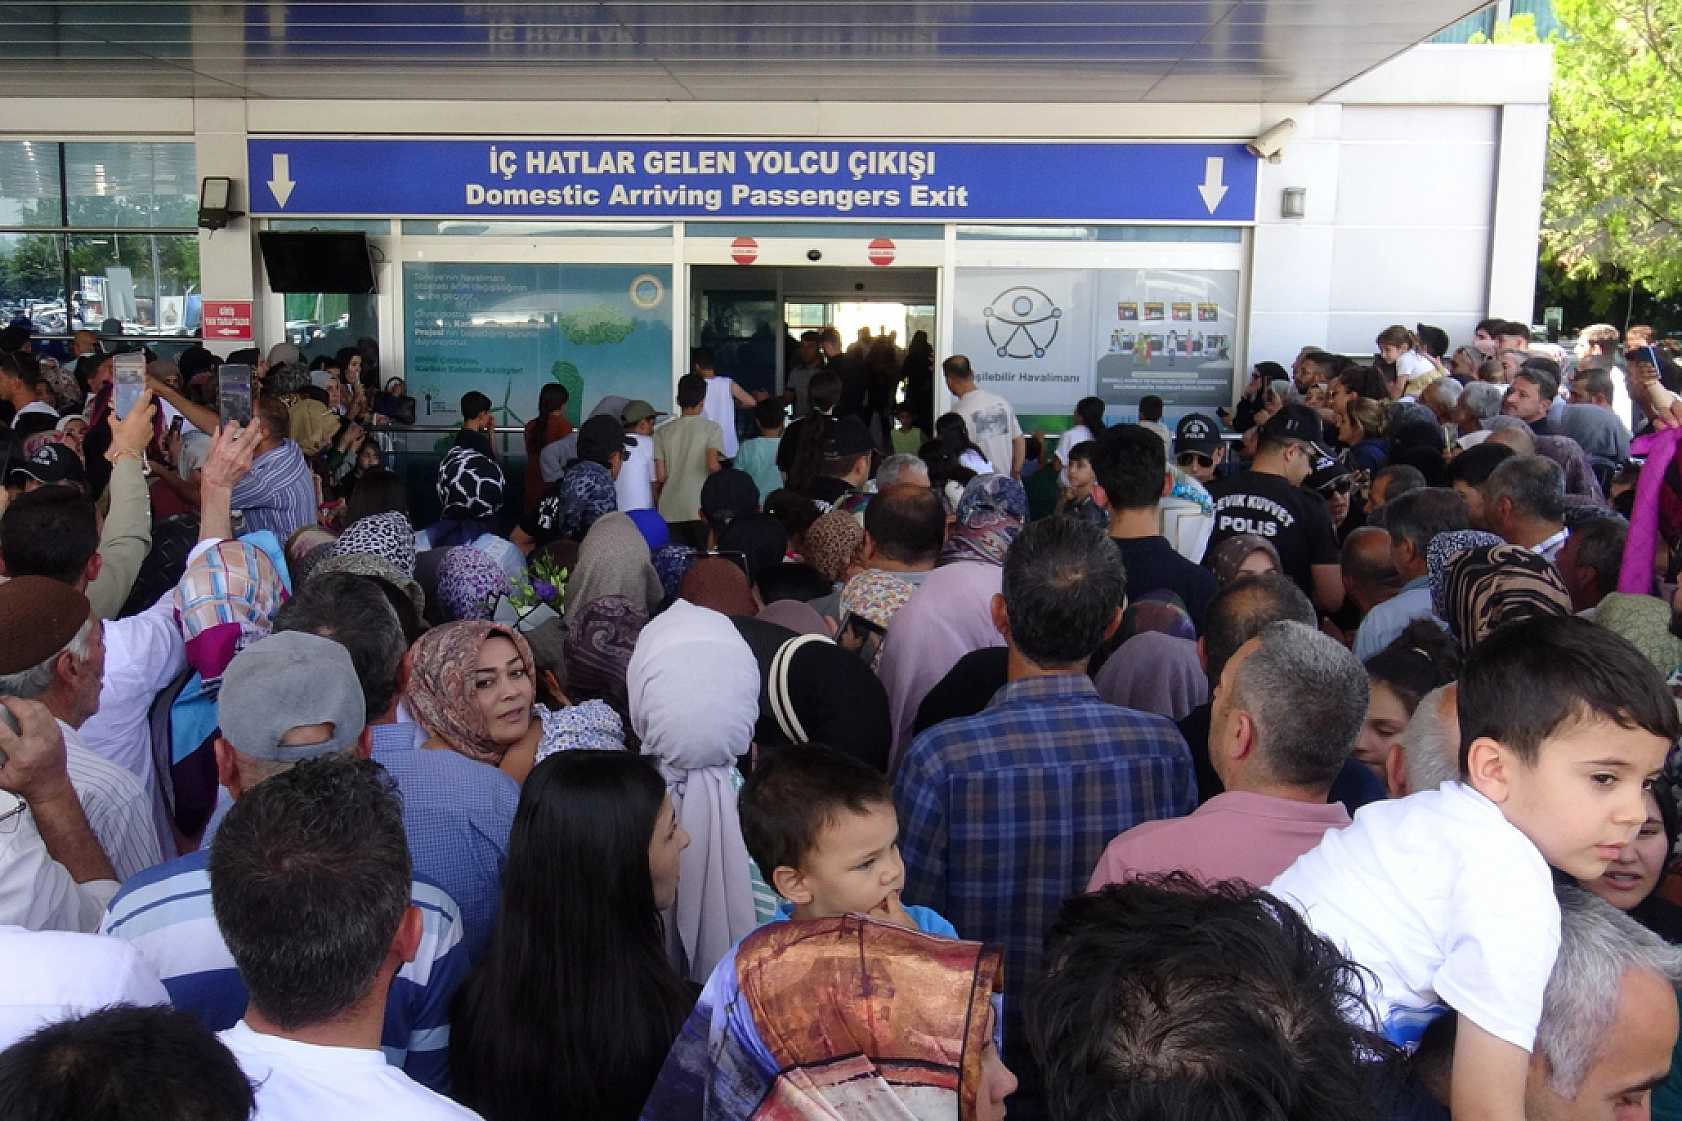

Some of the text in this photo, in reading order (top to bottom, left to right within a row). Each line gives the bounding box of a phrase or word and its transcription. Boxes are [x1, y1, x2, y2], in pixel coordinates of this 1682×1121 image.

[489, 145, 936, 181] İÇ HATLAR GELEN YOLCU ÇIKIŞI
[465, 183, 968, 212] Domestic Arriving Passengers Exit
[973, 371, 1080, 383] şilebilir Havalimanı
